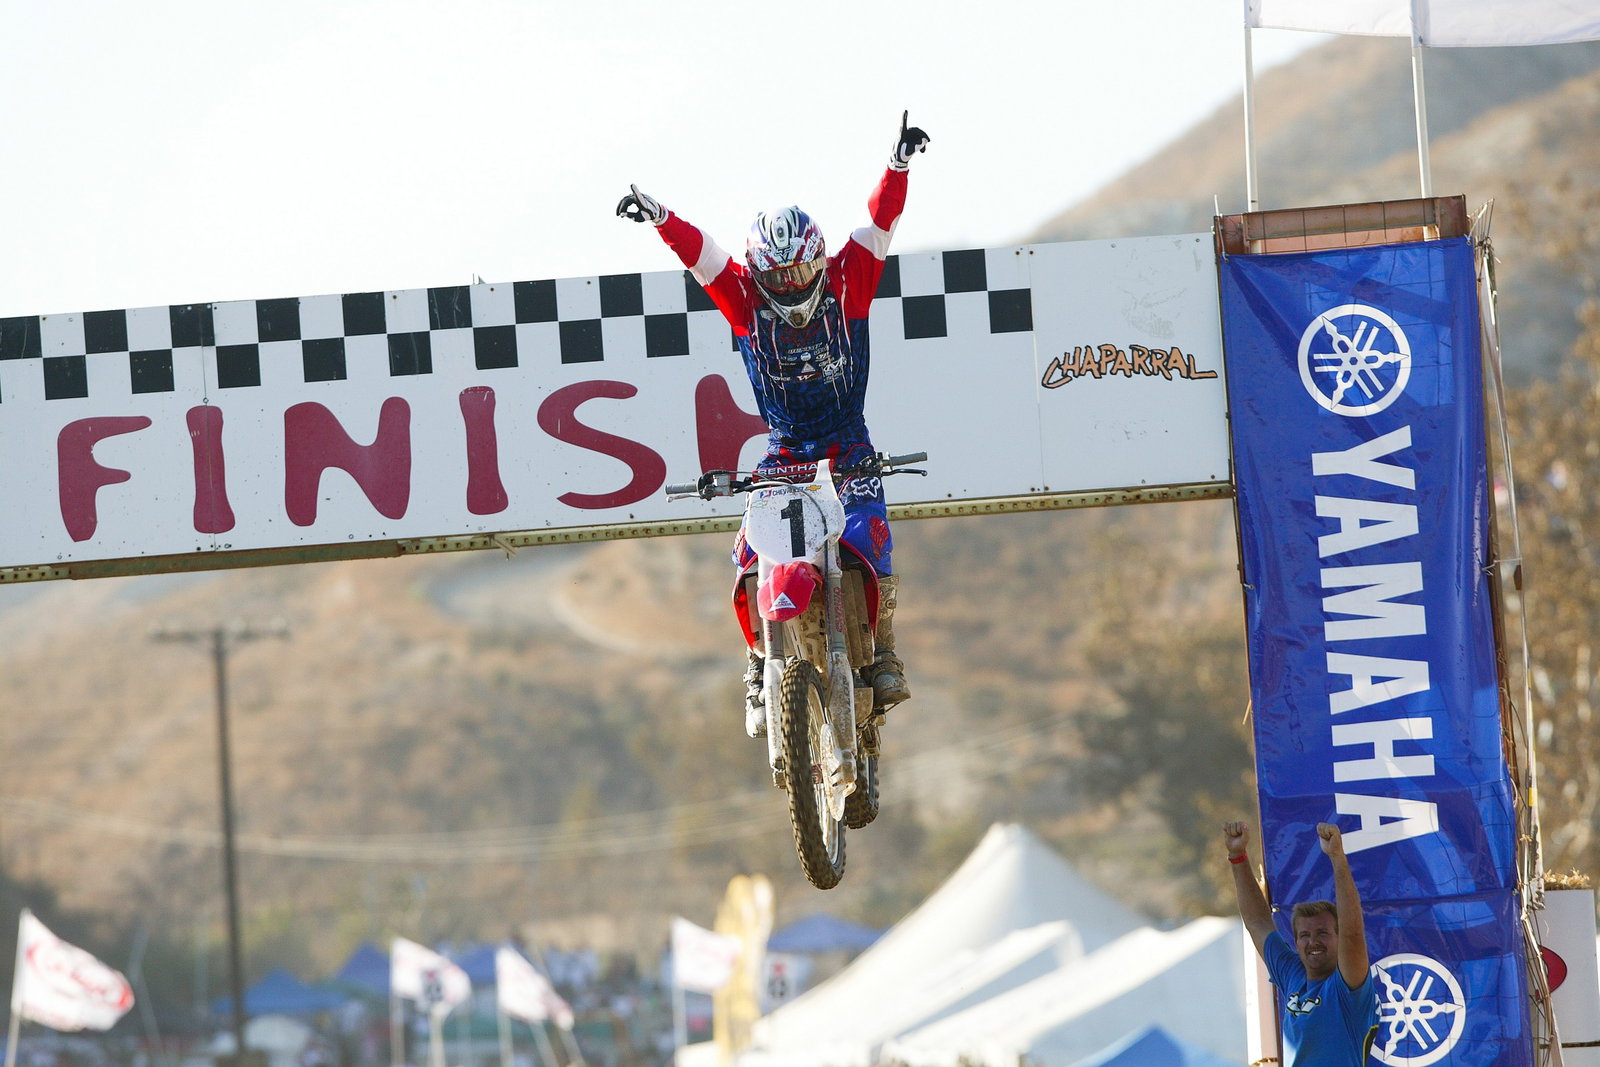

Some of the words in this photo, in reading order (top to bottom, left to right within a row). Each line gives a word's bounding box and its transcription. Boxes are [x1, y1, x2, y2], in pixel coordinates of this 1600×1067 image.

[1042, 343, 1218, 389] CHAPARRAL
[757, 463, 819, 476] RENTHA
[780, 498, 806, 558] 1
[1311, 425, 1439, 855] YAMAHA
